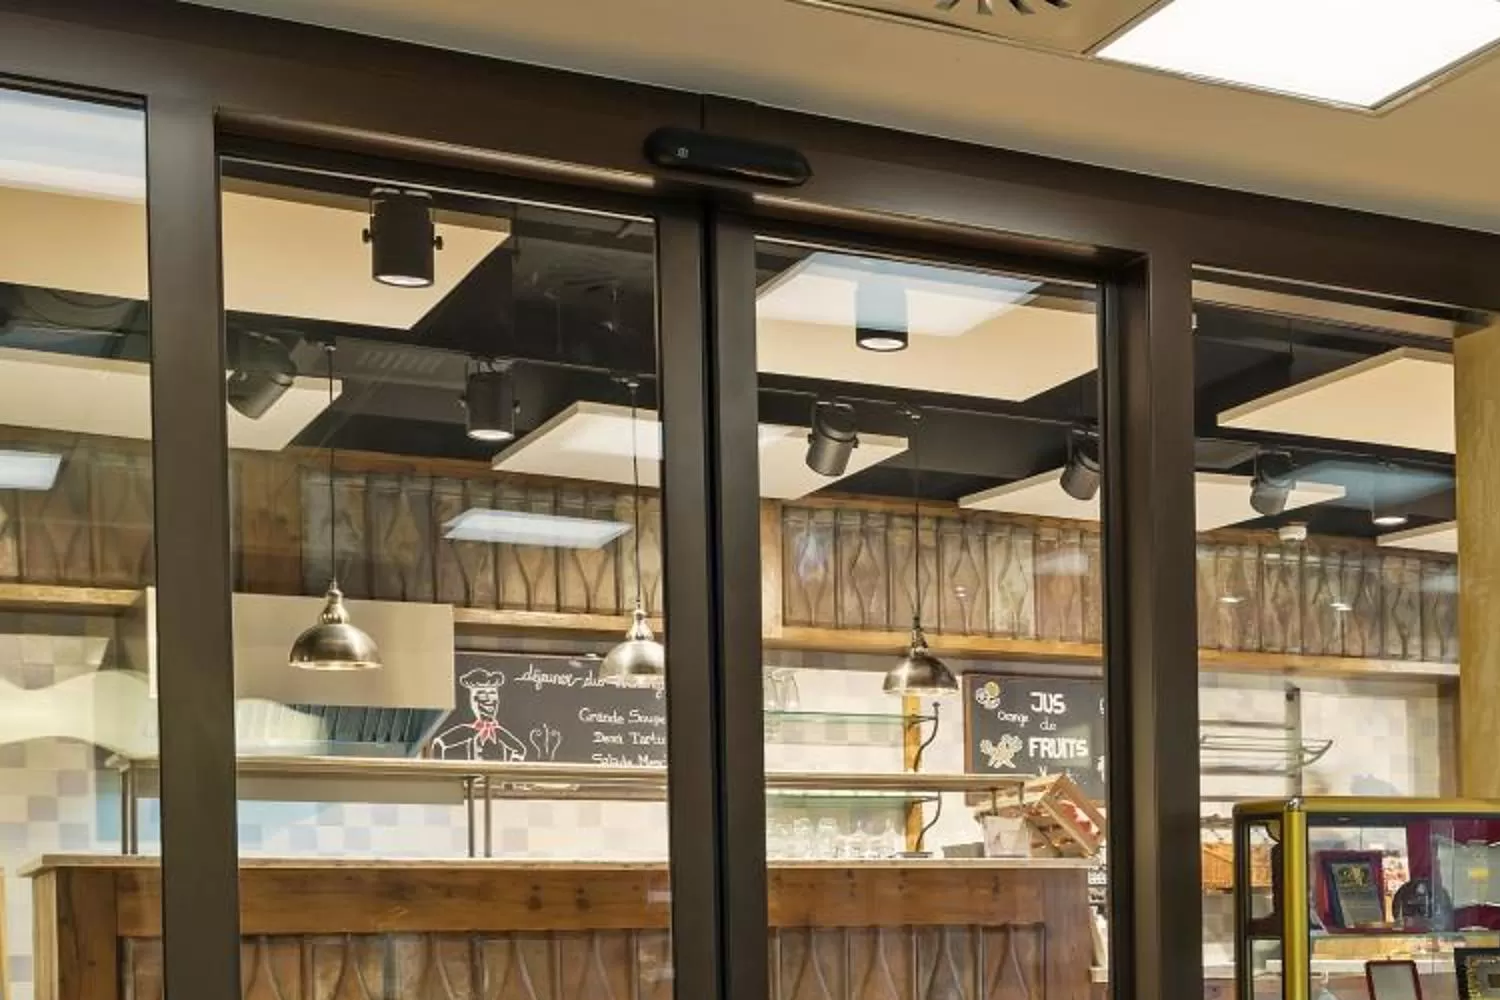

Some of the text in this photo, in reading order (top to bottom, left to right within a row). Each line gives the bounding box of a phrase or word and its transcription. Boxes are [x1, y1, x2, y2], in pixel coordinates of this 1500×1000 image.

[1029, 691, 1067, 715] JUS
[1039, 716, 1057, 731] de
[1028, 736, 1089, 759] FRUITS
